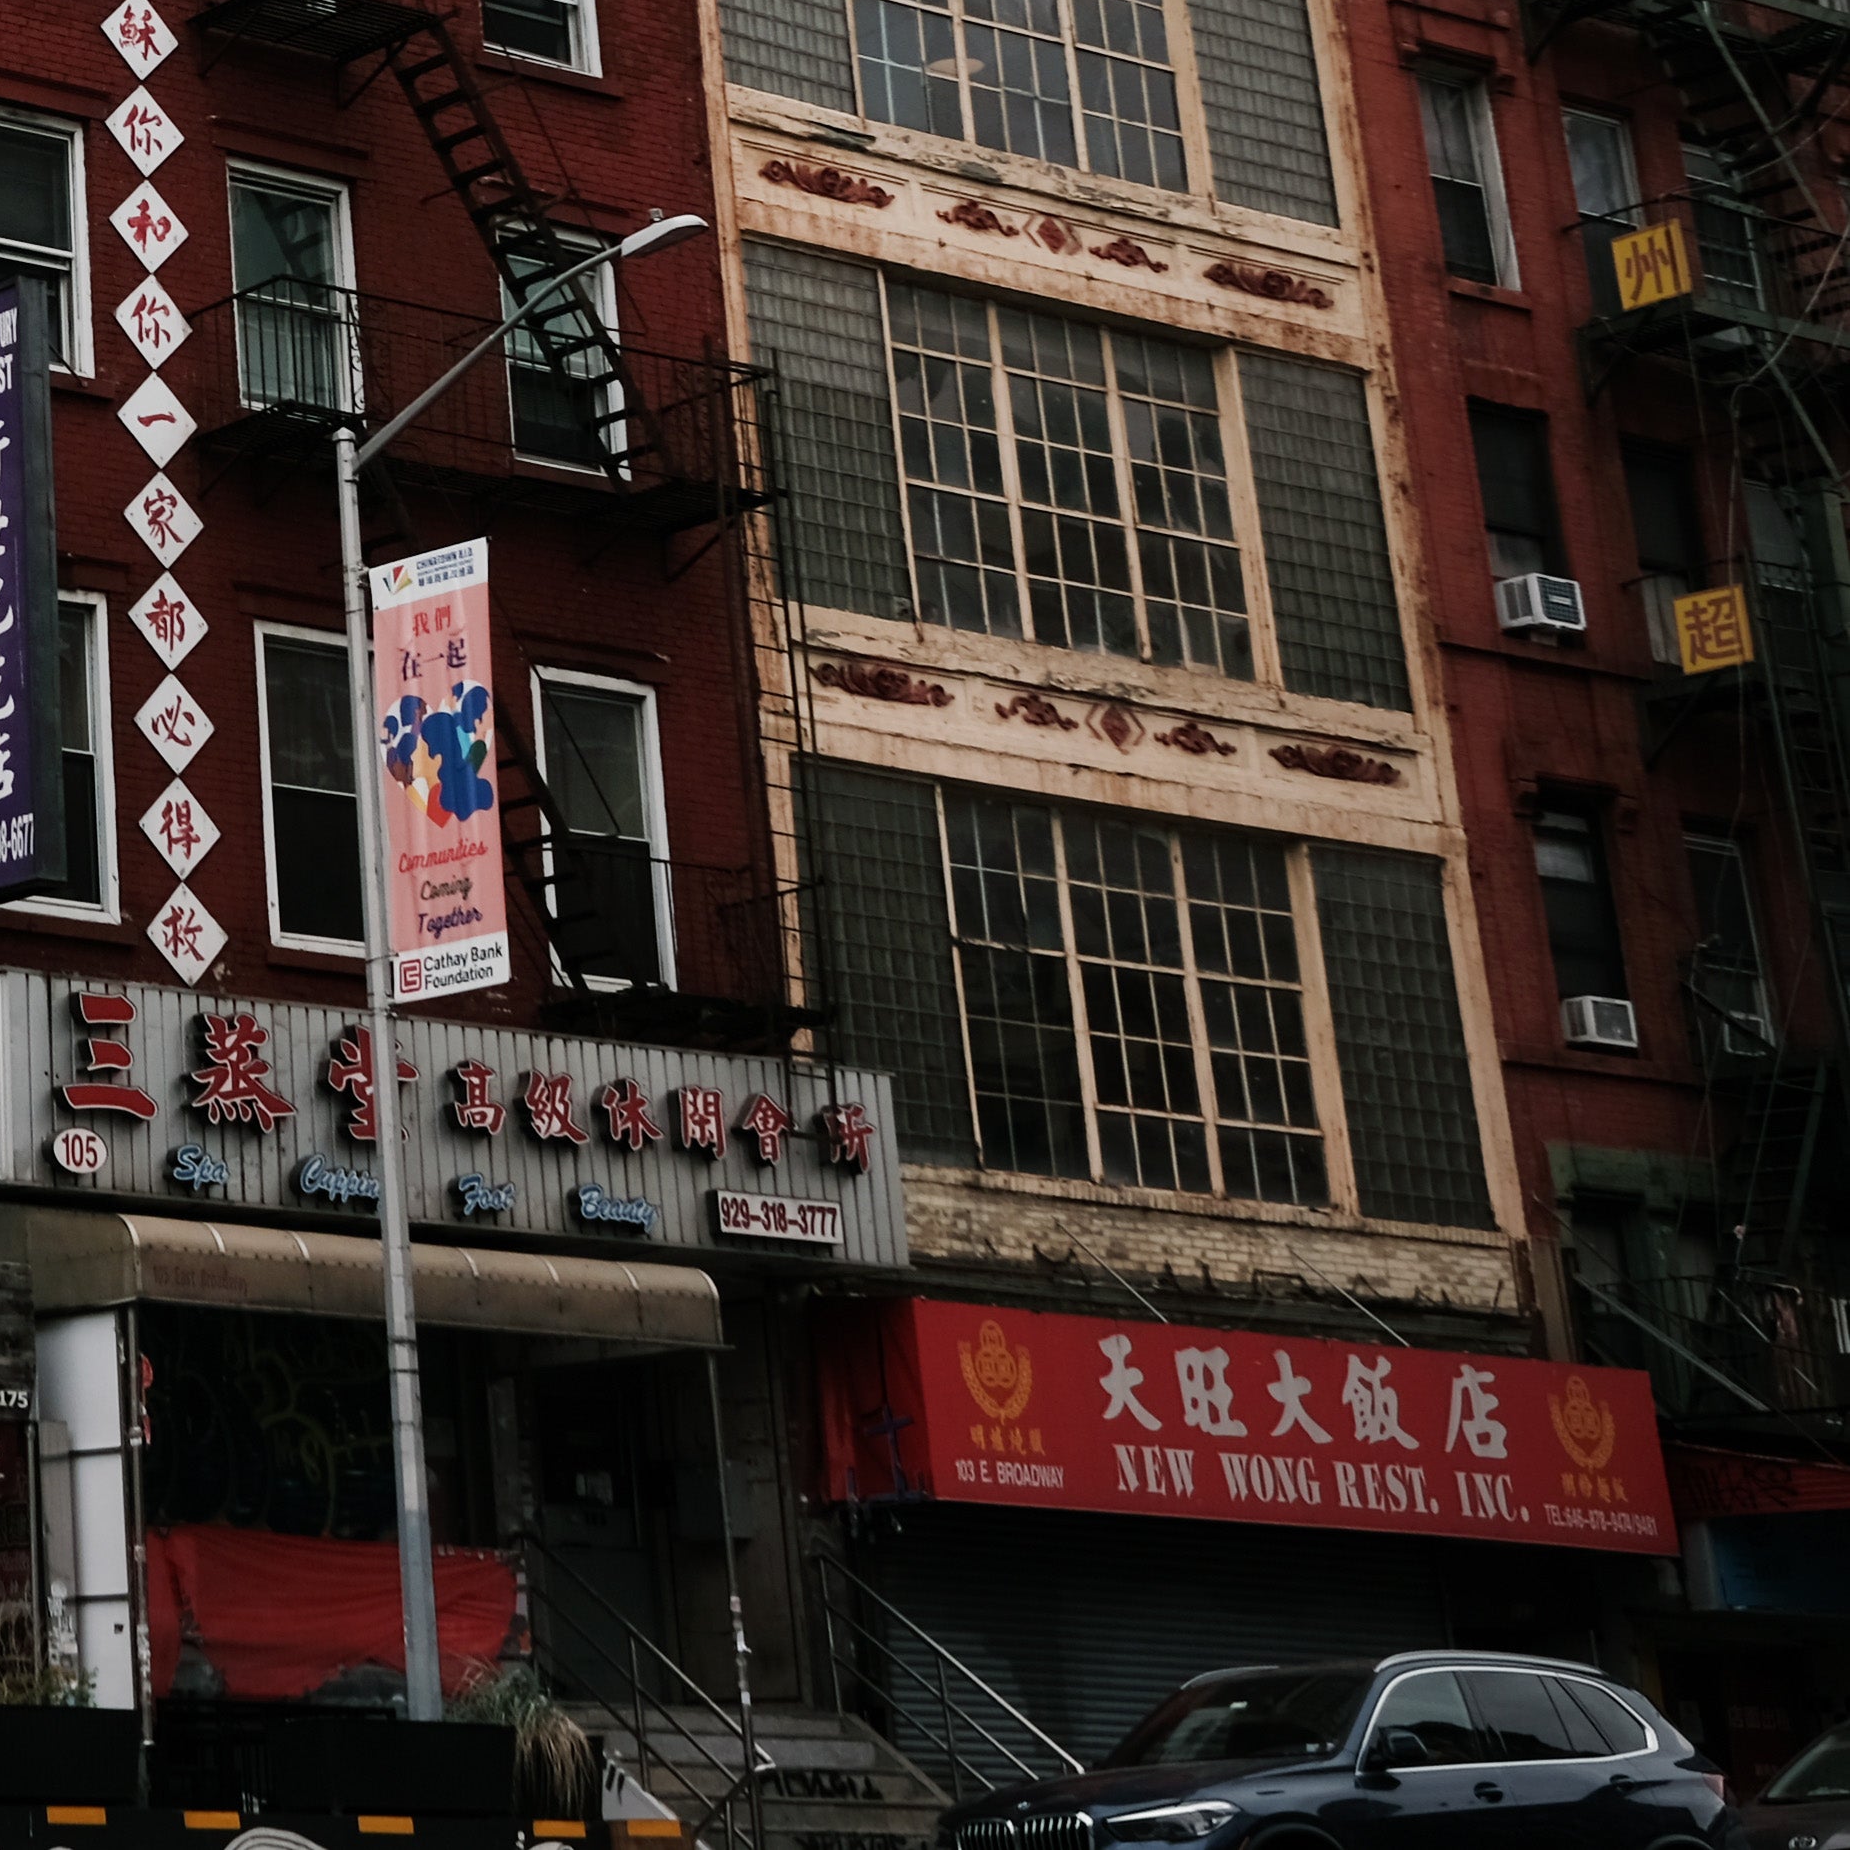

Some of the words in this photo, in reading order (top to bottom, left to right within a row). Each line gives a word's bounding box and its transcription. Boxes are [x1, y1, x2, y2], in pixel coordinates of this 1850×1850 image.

[398, 837, 488, 873] Communities
[421, 874, 473, 901] Coming
[418, 905, 483, 940] Together
[423, 952, 468, 972] Cathay
[470, 942, 503, 962] Bank
[424, 963, 494, 991] Foundation
[61, 1133, 98, 1168] 105
[173, 1144, 231, 1191] Spa
[300, 1152, 384, 1211] Cuppin
[457, 1171, 516, 1217] Foot
[578, 1182, 660, 1234] Beauty
[719, 1194, 839, 1240] 929-318-3777
[1097, 1332, 1509, 1459] 天旺大飯店
[955, 1458, 976, 1483] 103
[995, 1460, 1065, 1489] BROADWAY
[1113, 1443, 1197, 1499] NEW
[1217, 1452, 1322, 1518] WONG
[1336, 1459, 1440, 1517] REST.
[1455, 1470, 1532, 1524] INC.
